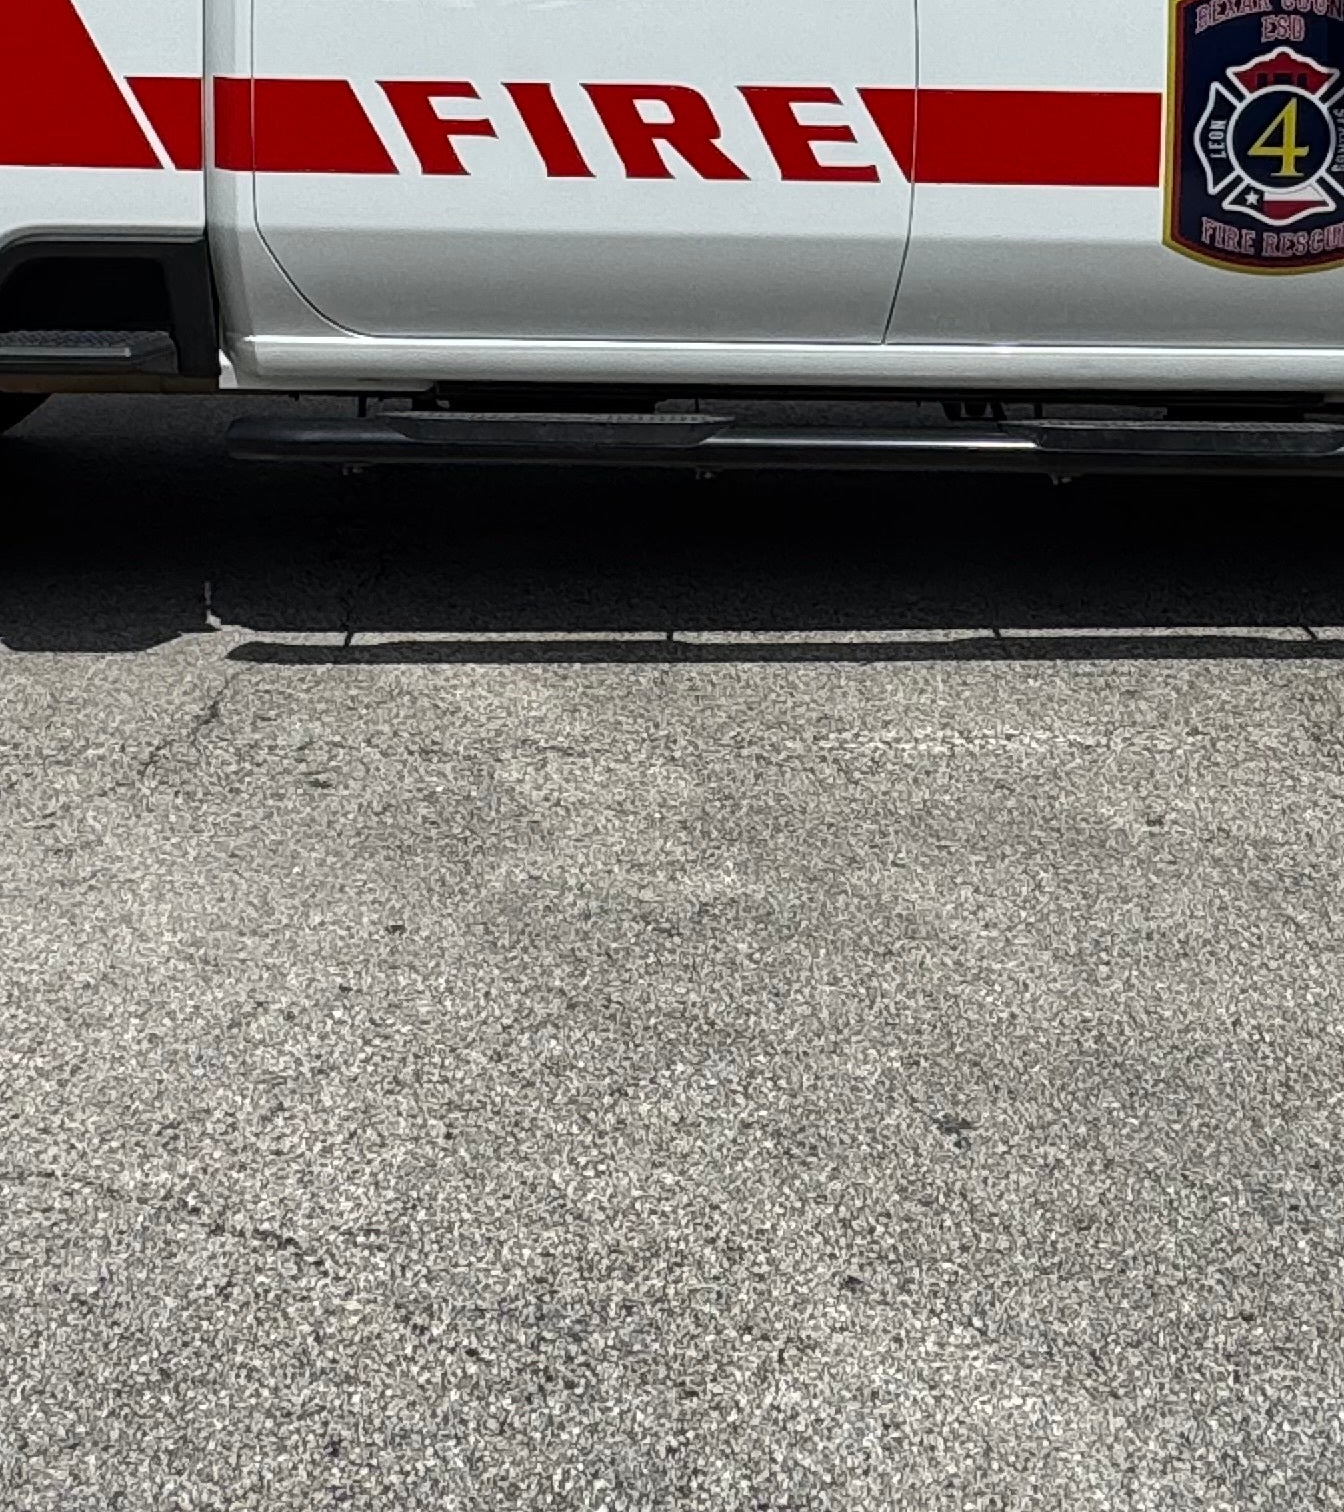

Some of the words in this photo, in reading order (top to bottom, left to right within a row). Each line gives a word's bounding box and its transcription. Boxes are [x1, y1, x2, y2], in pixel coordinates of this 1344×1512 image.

[1261, 14, 1305, 42] ESD
[375, 80, 881, 183] FIRE
[1208, 118, 1227, 159] LEON
[1248, 97, 1309, 177] 4
[1201, 217, 1256, 256] FIRE
